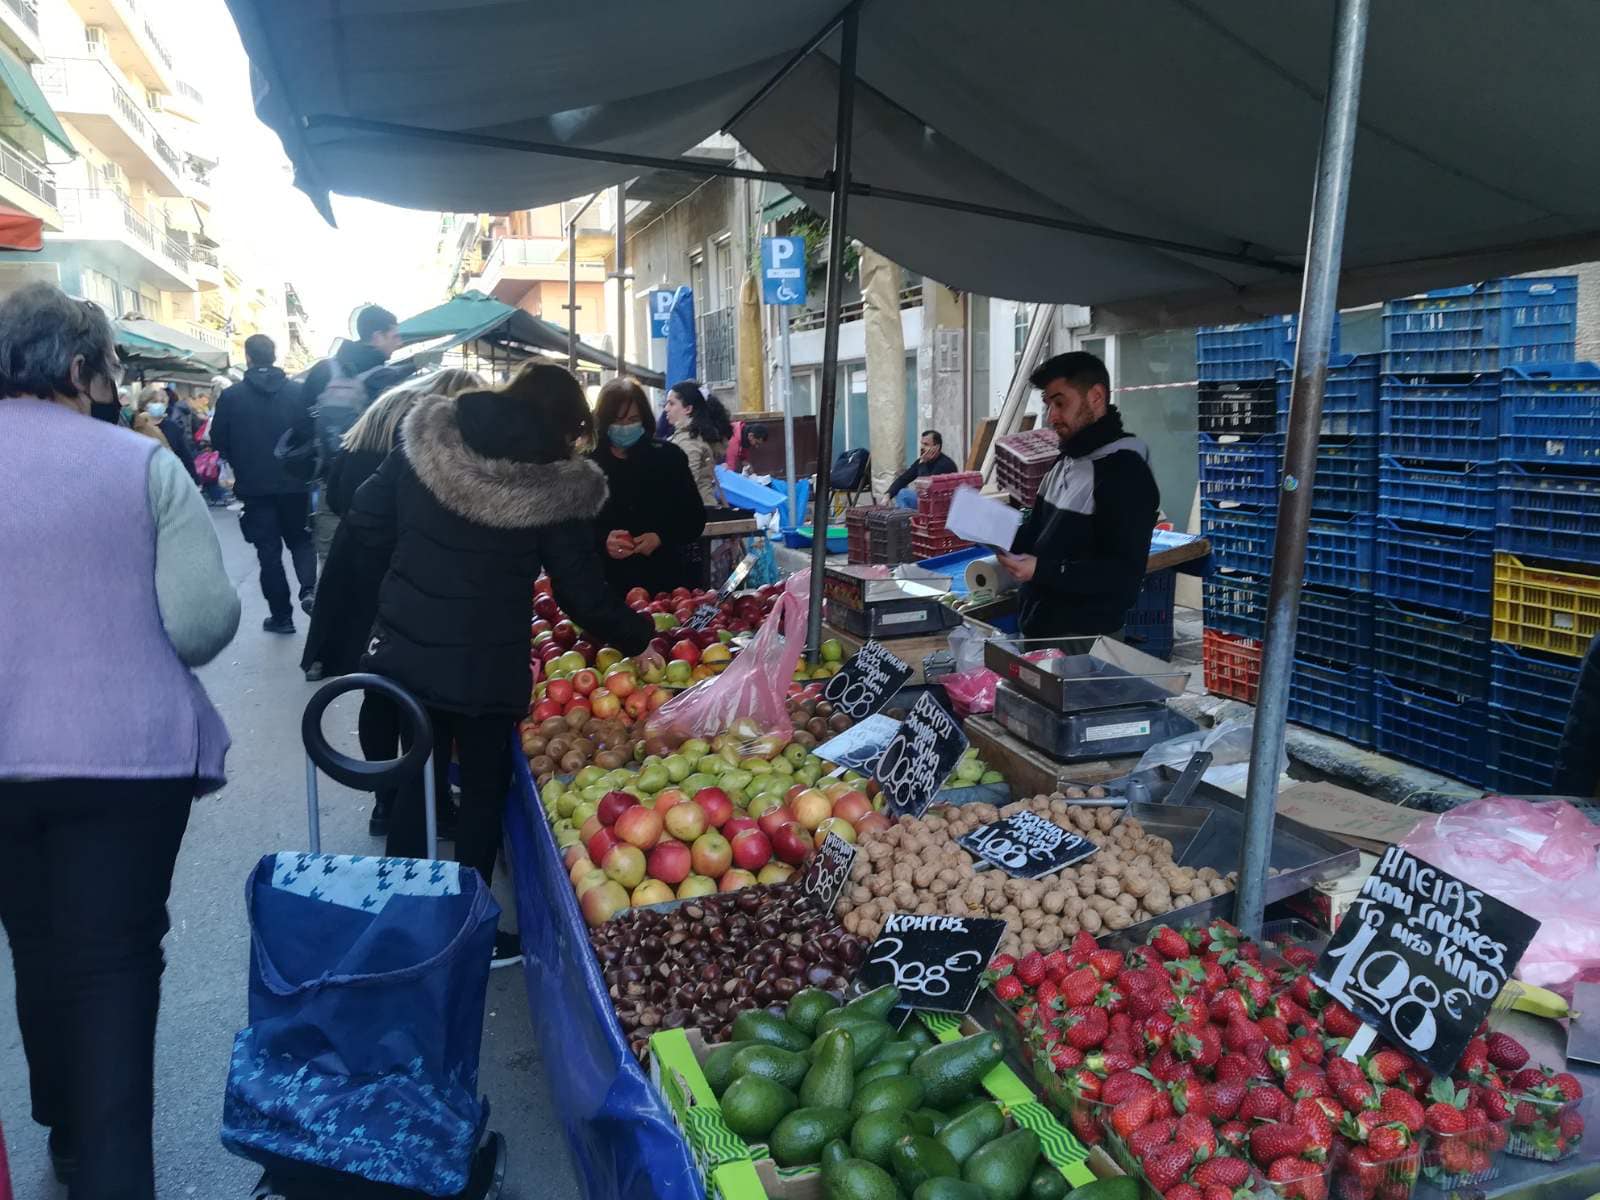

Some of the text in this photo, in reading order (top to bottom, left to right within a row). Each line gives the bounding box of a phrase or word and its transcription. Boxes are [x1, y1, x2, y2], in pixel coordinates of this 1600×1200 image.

[772, 239, 794, 268] P
[657, 292, 672, 313] P
[885, 914, 969, 933] ΚΡΗΤΗΣ
[1354, 898, 1384, 927] ΤΟ
[1435, 936, 1499, 999] ΚΙΛΟ
